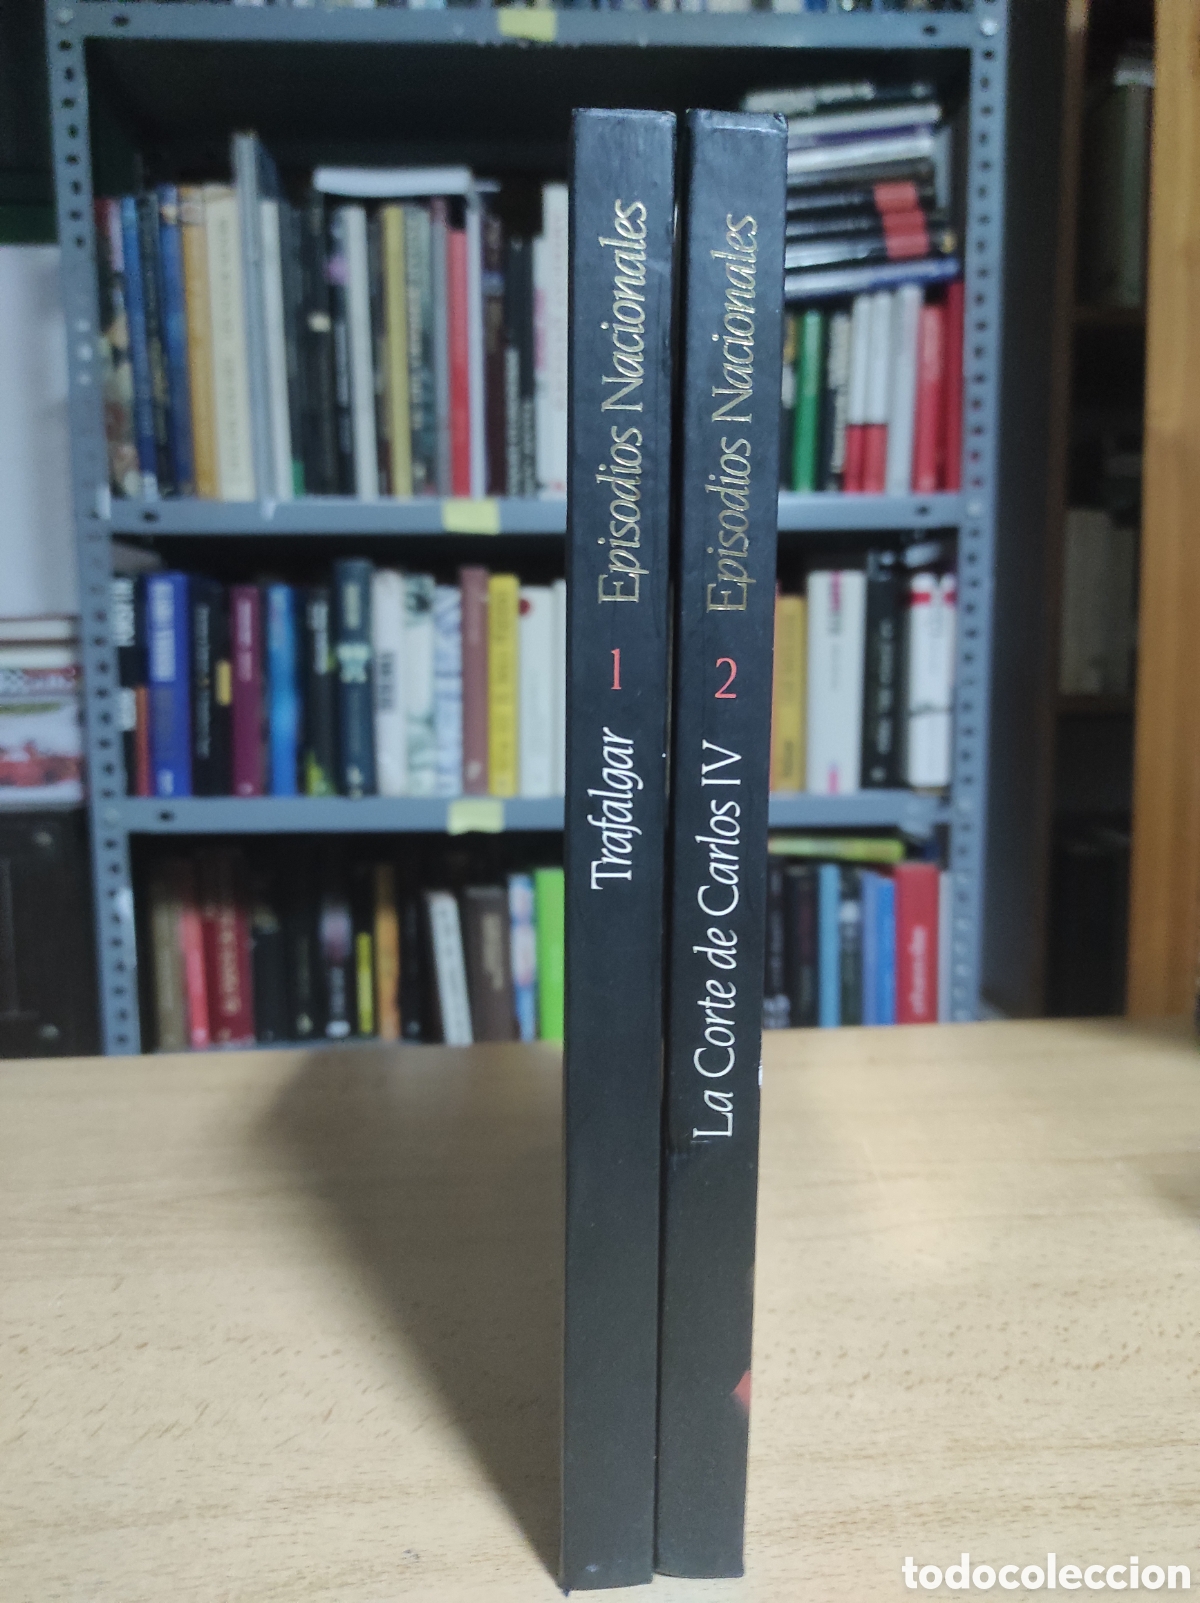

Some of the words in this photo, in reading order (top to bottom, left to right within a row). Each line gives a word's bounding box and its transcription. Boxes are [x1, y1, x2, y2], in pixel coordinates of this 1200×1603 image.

[598, 198, 649, 413] Nacionales
[710, 213, 758, 424] Nacionales
[596, 426, 649, 604] Episodios
[705, 437, 757, 613] Episodios
[610, 649, 622, 690] 1
[715, 657, 737, 699] 2
[587, 727, 644, 890] Trafalgar
[702, 740, 742, 787] IV
[695, 799, 741, 916] Carlos
[693, 929, 737, 969] de
[693, 978, 735, 1078] Corte
[692, 1090, 734, 1139] La
